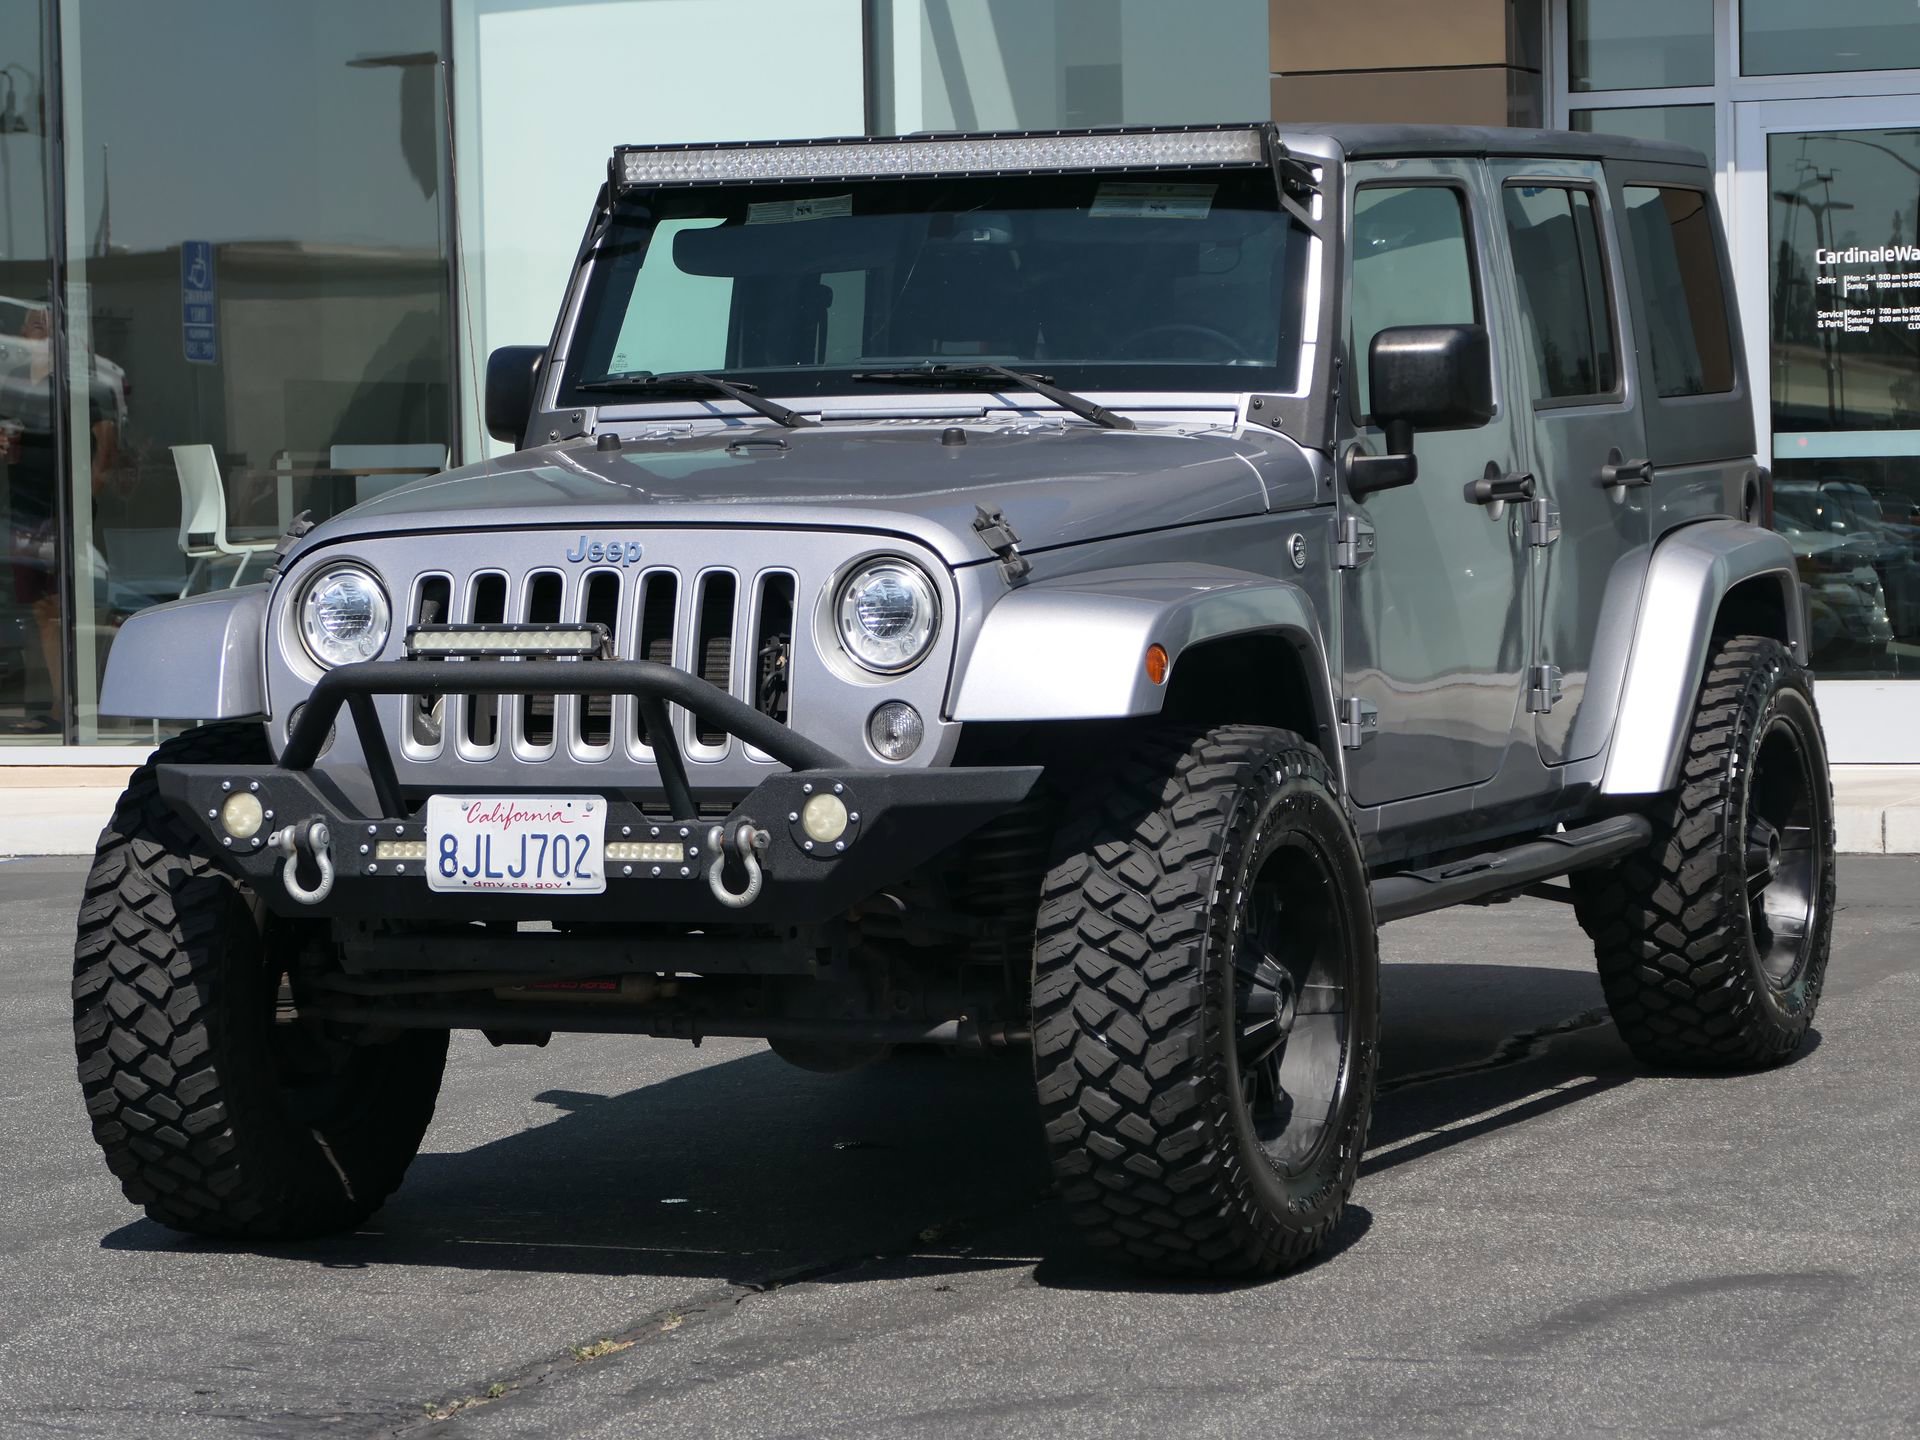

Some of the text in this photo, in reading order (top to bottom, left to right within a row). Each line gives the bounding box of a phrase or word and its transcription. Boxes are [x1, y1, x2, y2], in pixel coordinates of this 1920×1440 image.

[1816, 245, 1920, 265] CardinaleWa
[1817, 276, 1837, 285] Sales
[1847, 282, 1869, 291] Sunday
[1817, 310, 1844, 319] Service
[1879, 307, 1891, 315] 7:00
[1817, 320, 1844, 328] & Parts
[1847, 317, 1874, 325] Saturday
[1847, 325, 1870, 333] Sunday
[566, 535, 643, 568] Jeep
[467, 801, 574, 830] California
[439, 833, 592, 879] 8JLJ702
[473, 880, 563, 890] dmv.ca.gov
